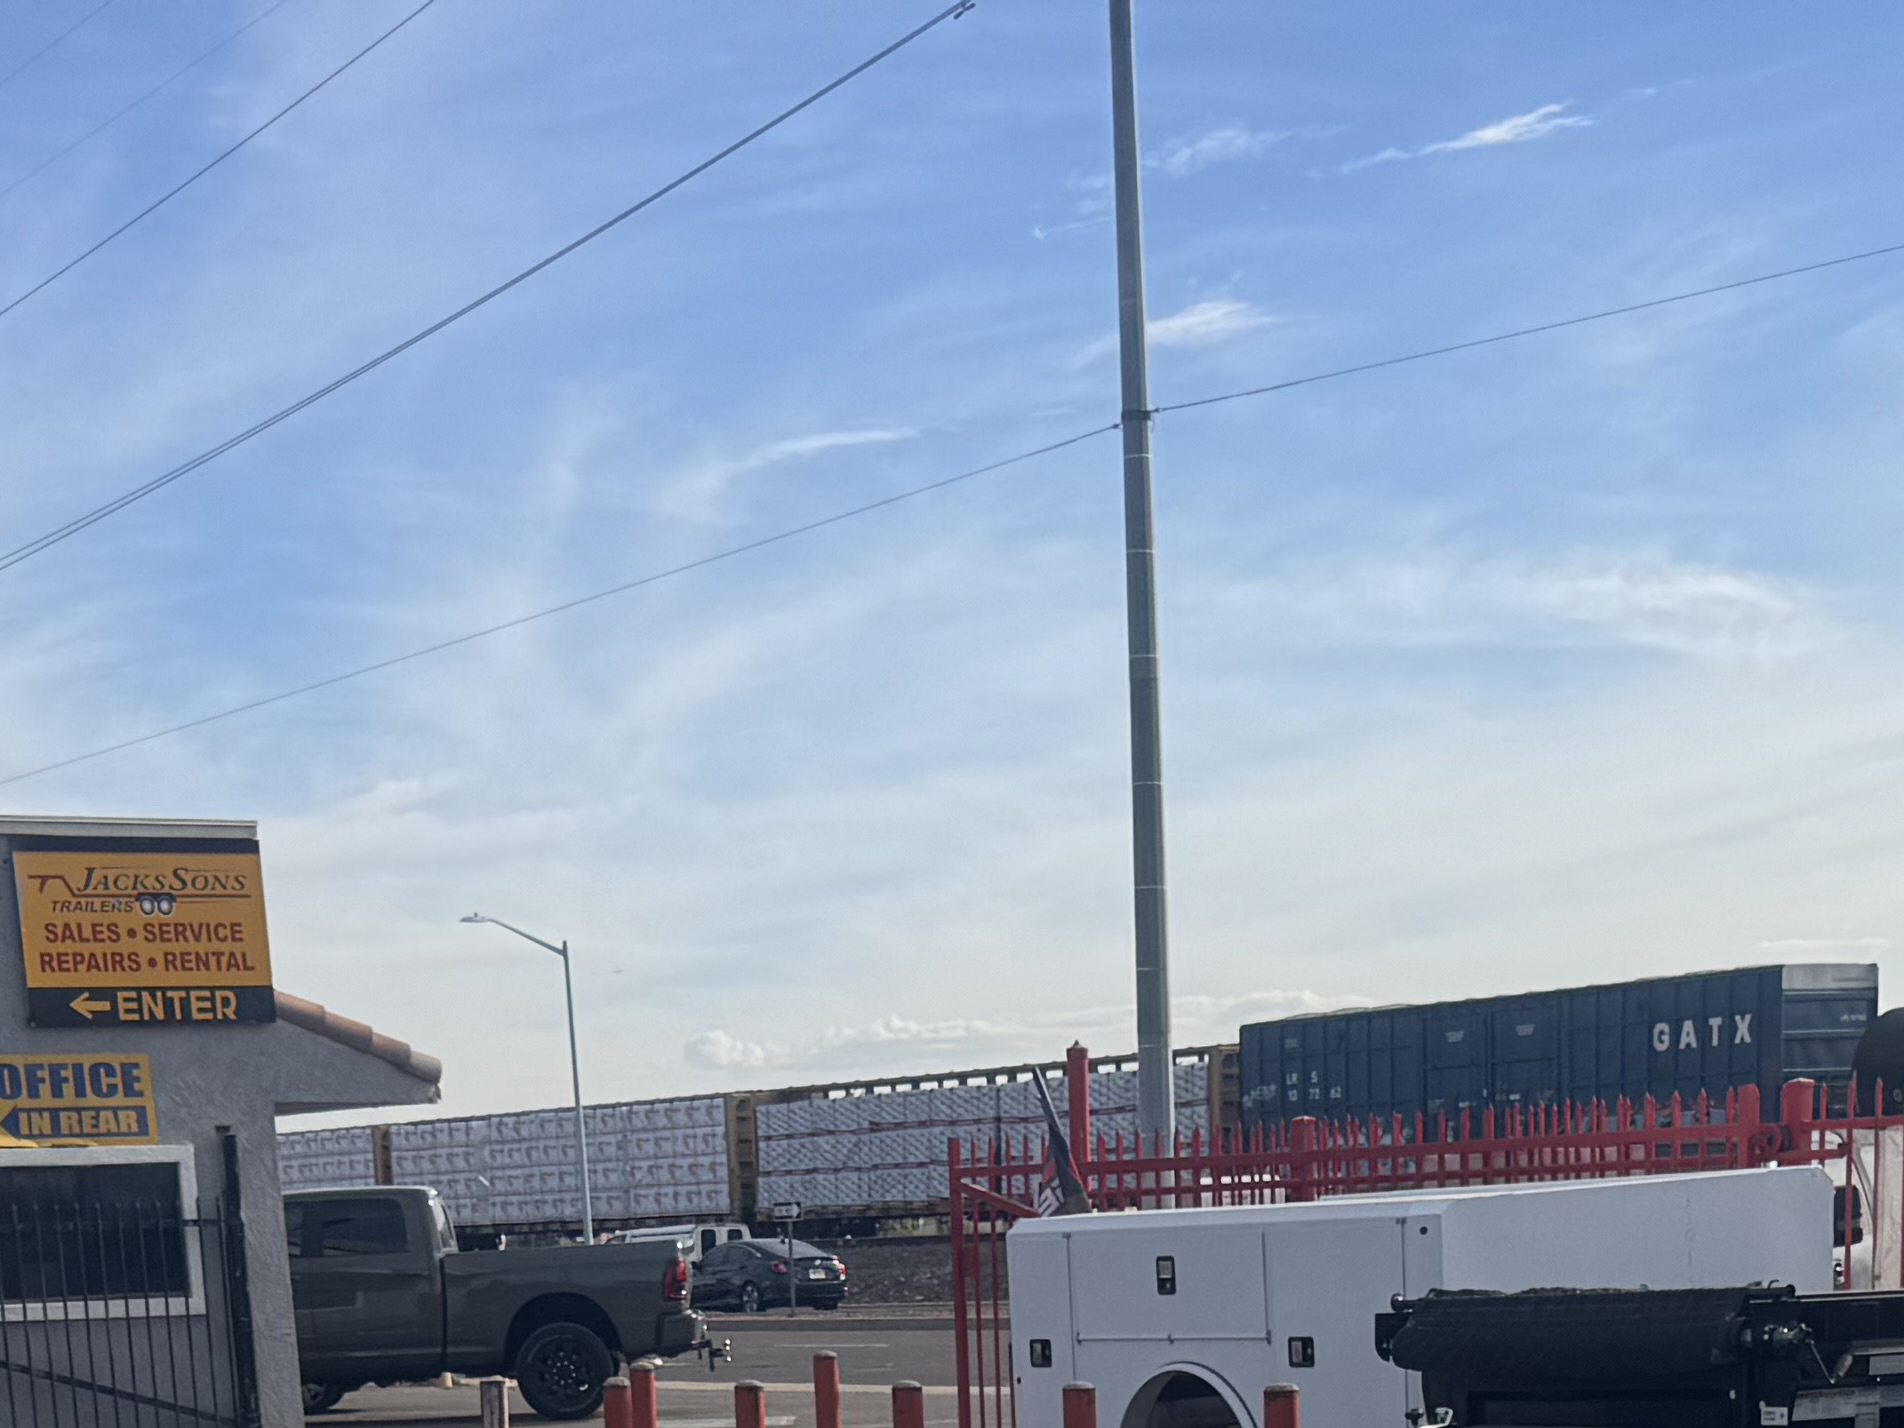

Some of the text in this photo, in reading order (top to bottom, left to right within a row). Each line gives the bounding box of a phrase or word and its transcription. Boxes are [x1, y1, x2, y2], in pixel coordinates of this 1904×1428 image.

[51, 899, 134, 913] TRAILERS
[44, 922, 244, 944] SALES SERVICE
[39, 951, 255, 973] REPAIRS RENTAL
[117, 990, 238, 1021] ENTER
[1652, 1013, 1752, 1052] GATX
[18, 1109, 139, 1136] IN REAR
